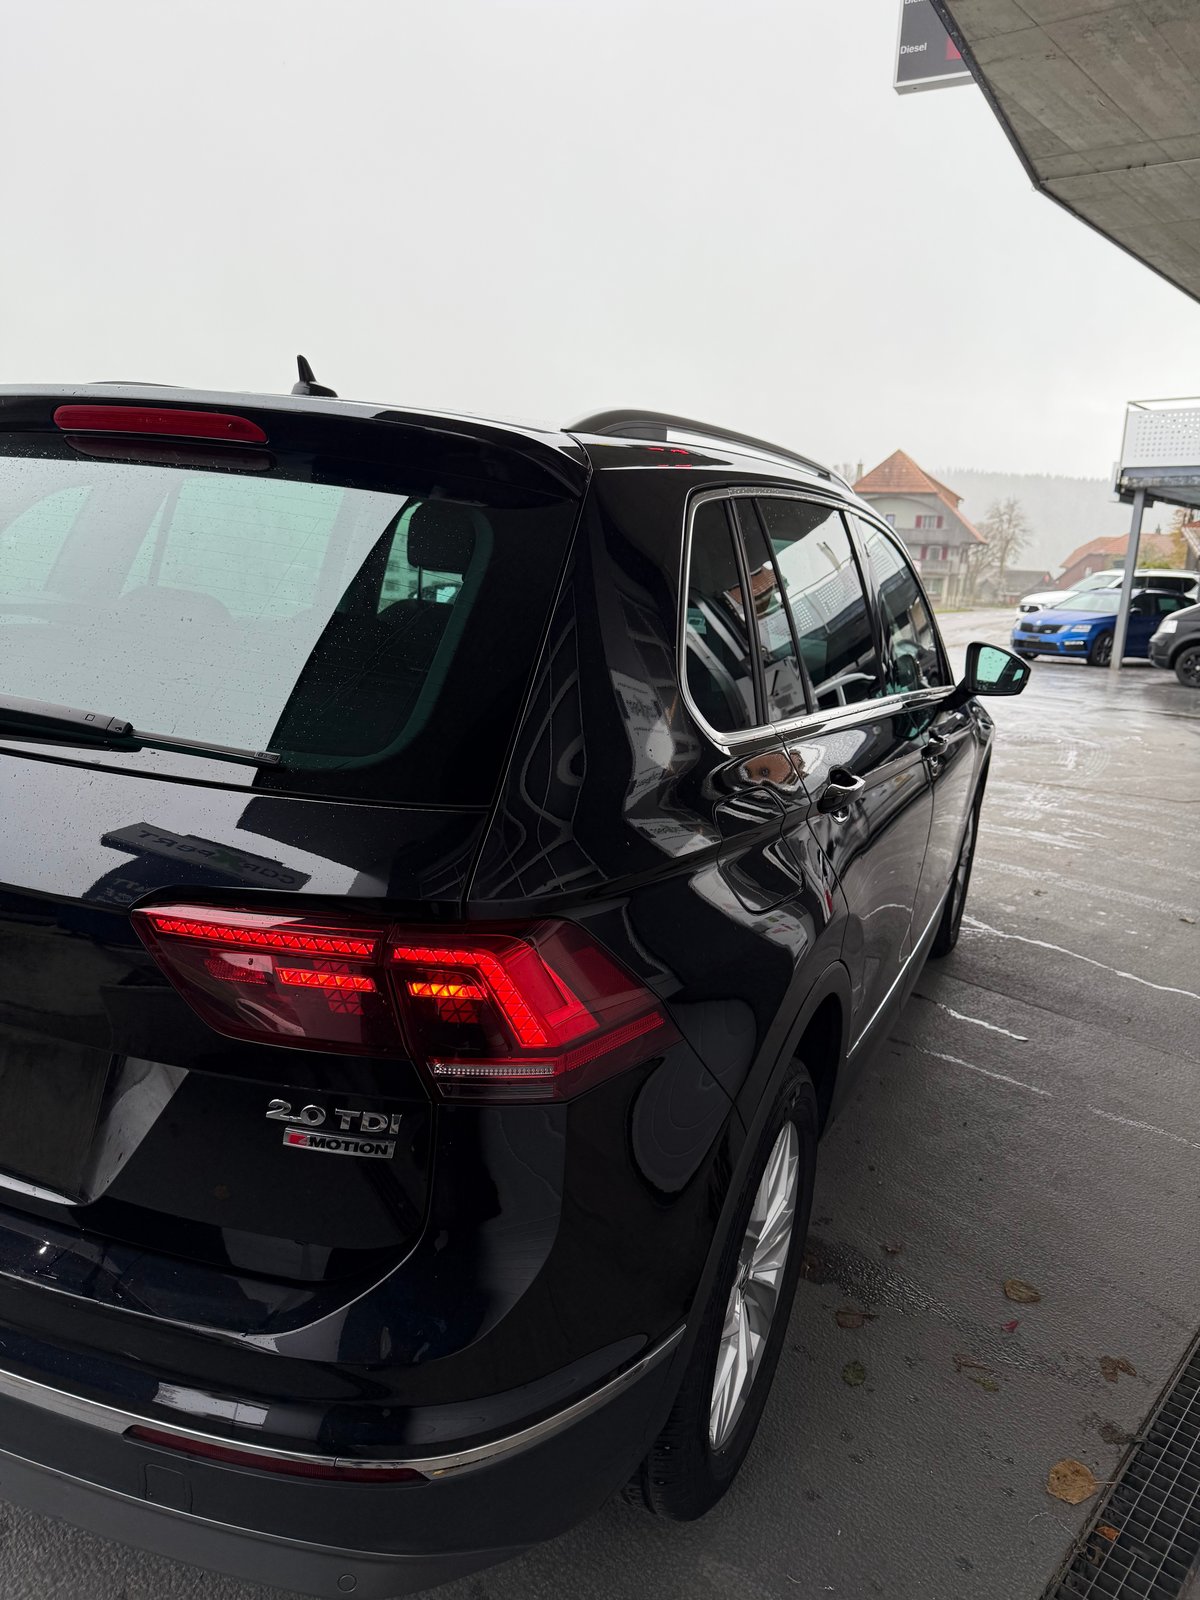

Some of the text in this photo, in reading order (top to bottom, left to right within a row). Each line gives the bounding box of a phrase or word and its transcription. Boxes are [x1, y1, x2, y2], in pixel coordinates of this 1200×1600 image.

[900, 42, 928, 55] Diesel
[265, 1098, 402, 1135] 2.0 TDI
